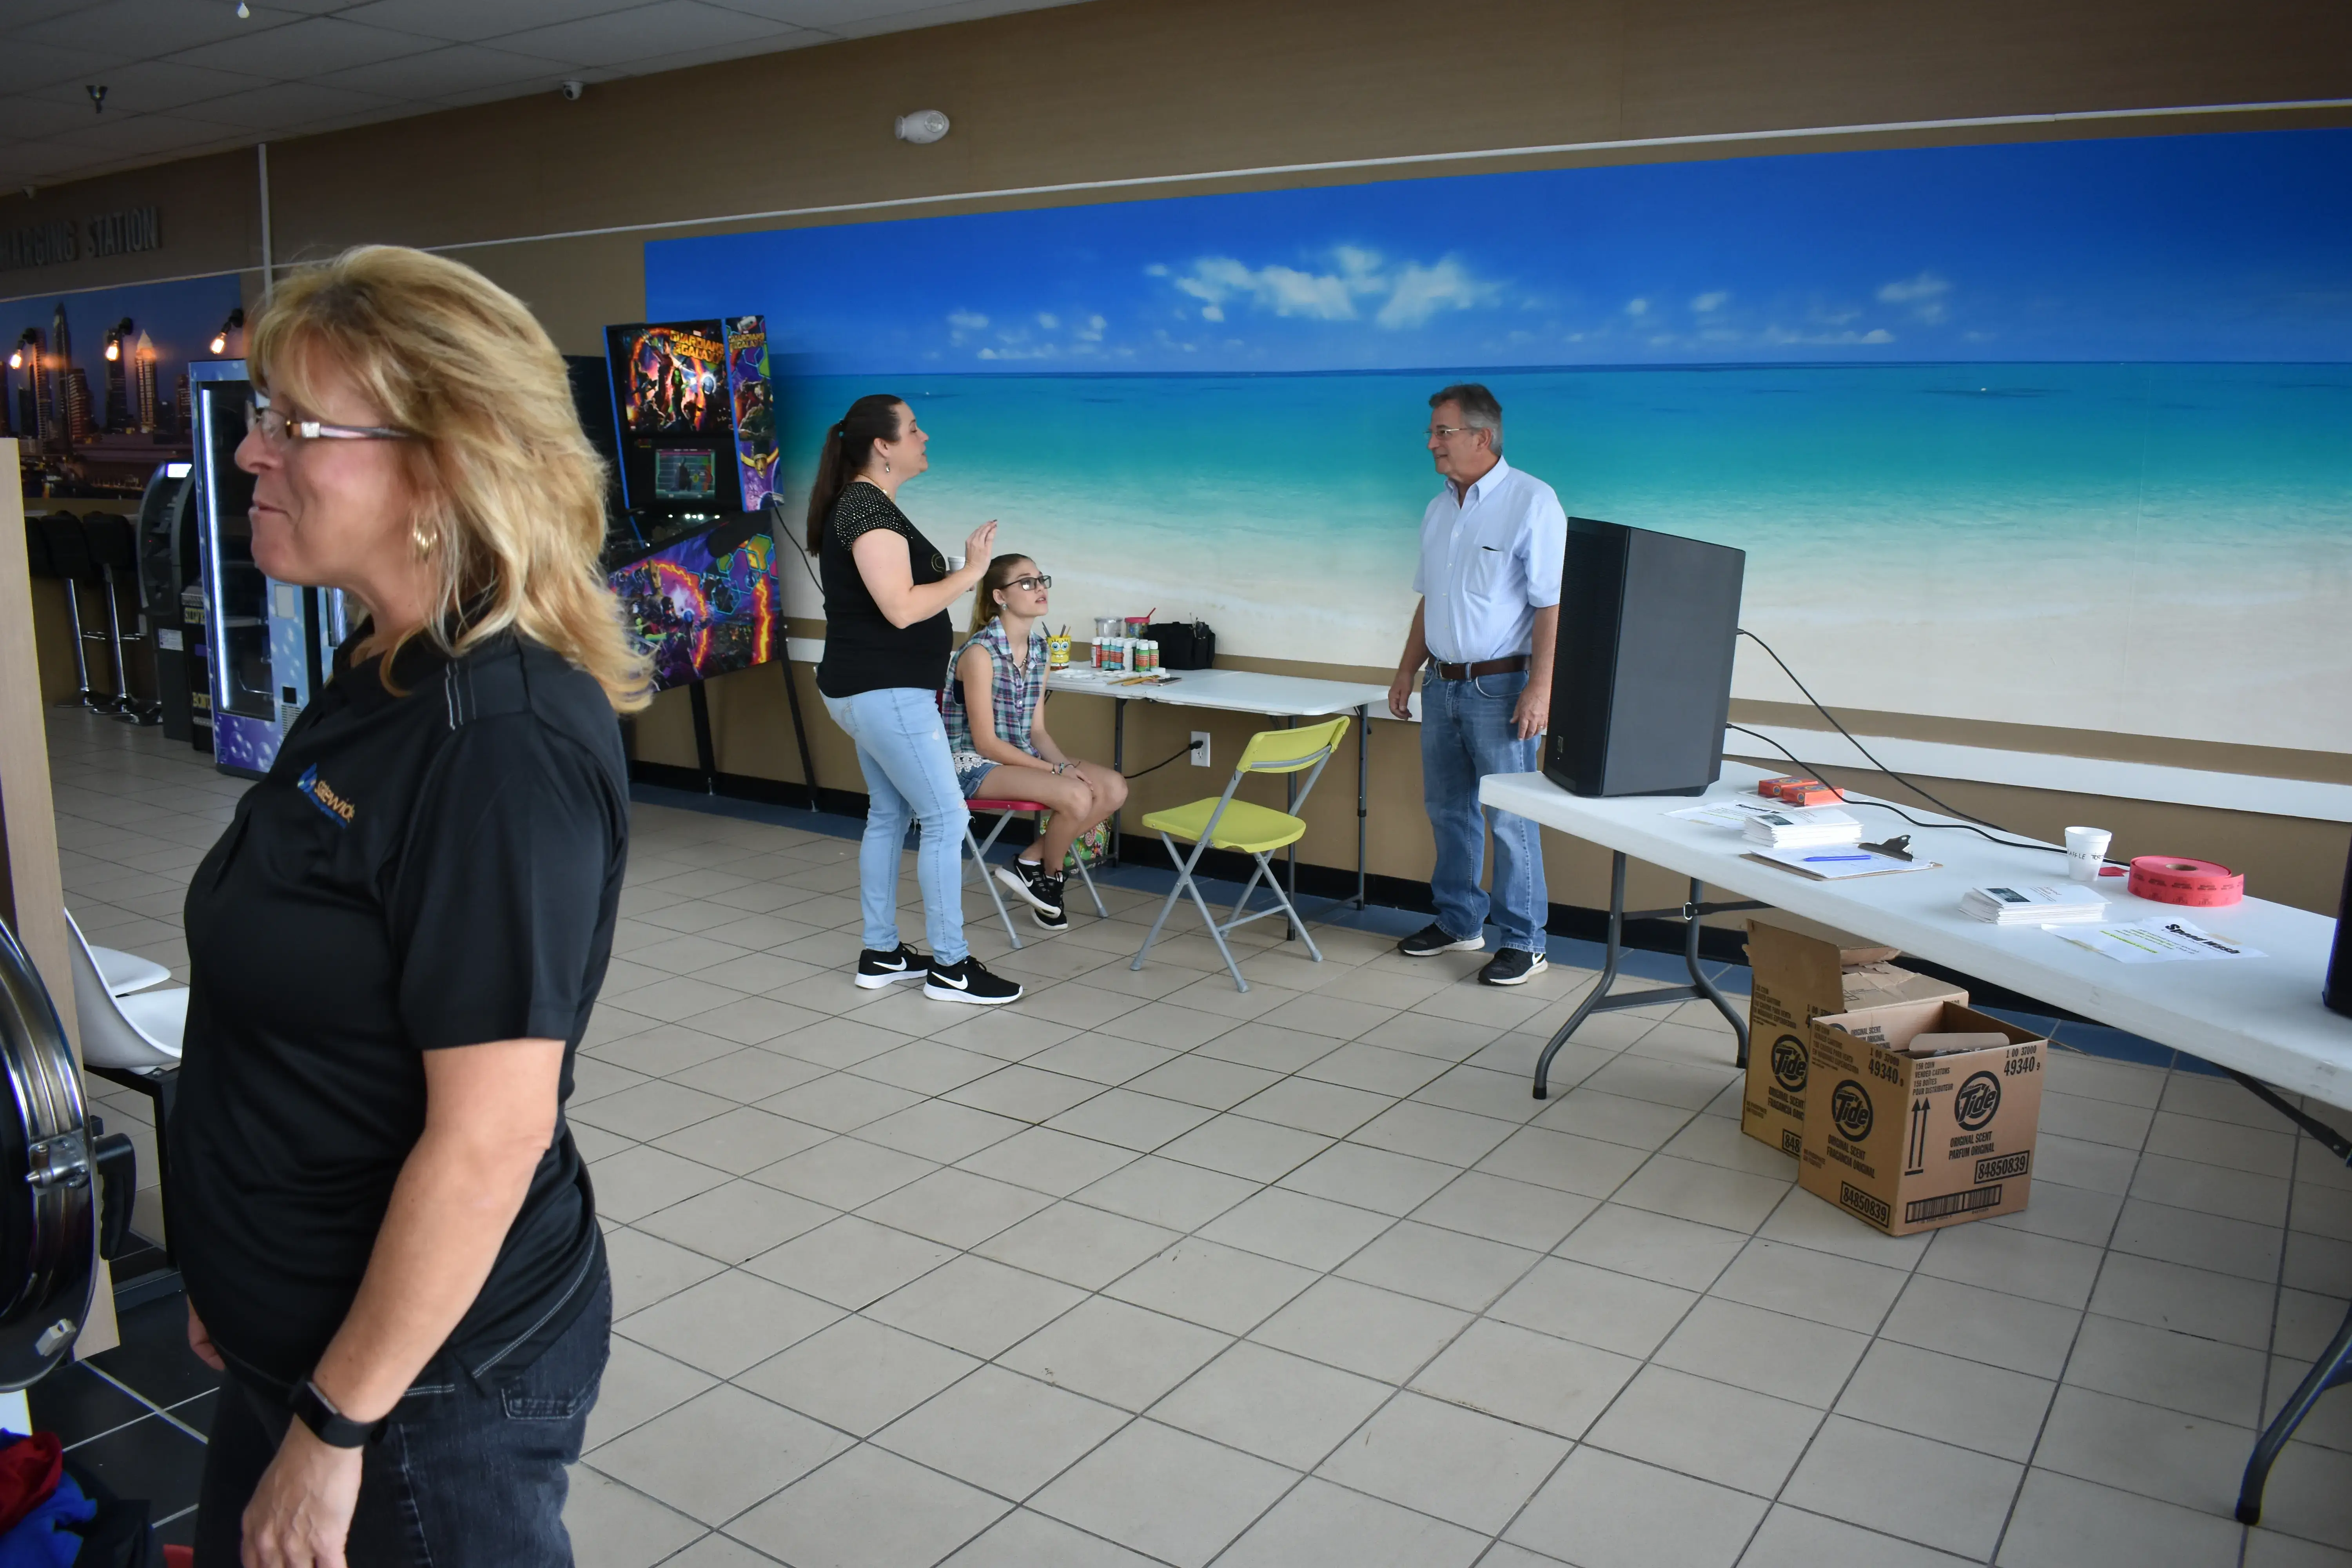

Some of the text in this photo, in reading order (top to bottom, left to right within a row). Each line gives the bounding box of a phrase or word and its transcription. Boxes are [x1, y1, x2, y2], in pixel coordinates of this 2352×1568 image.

[83, 206, 157, 256] STATION
[670, 330, 724, 354] GUARDIANS
[681, 344, 724, 364] GALAXY
[2165, 924, 2209, 941] Speed
[2201, 941, 2241, 954] Wash
[1851, 1026, 1881, 1036] ORIGINAL SCENT
[1775, 1047, 1807, 1076] Tide
[1870, 1047, 1873, 1056] 1
[1875, 1049, 1882, 1059] 00
[2006, 1045, 2037, 1058] 1 00 37000
[1868, 1058, 1898, 1084] 49340
[1915, 1067, 1951, 1078] VENDED CARTONS
[1924, 1061, 1935, 1069] COIN
[2004, 1056, 2040, 1076] 49340 9
[1912, 1083, 1954, 1096] POUR DISTRIBUTEUR
[1922, 1078, 1937, 1087] BOÎTES
[1789, 1095, 1804, 1110] SCENT
[1835, 1093, 1870, 1125] Tide
[1958, 1085, 1997, 1123] Tide
[1793, 1109, 1804, 1121] ORIG
[1785, 1134, 1802, 1153] 848
[1828, 1134, 1866, 1160] ORIGINAL SCENT
[1950, 1131, 1992, 1147] ORIGINAL SCENT
[1949, 1142, 1994, 1160] PARFUM ORIGINAL
[1827, 1146, 1852, 1168] FRAGANCIA
[1853, 1157, 1875, 1178] ORIGINAL
[1978, 1155, 2026, 1179] 84850839
[1843, 1187, 1887, 1222] 84850839
